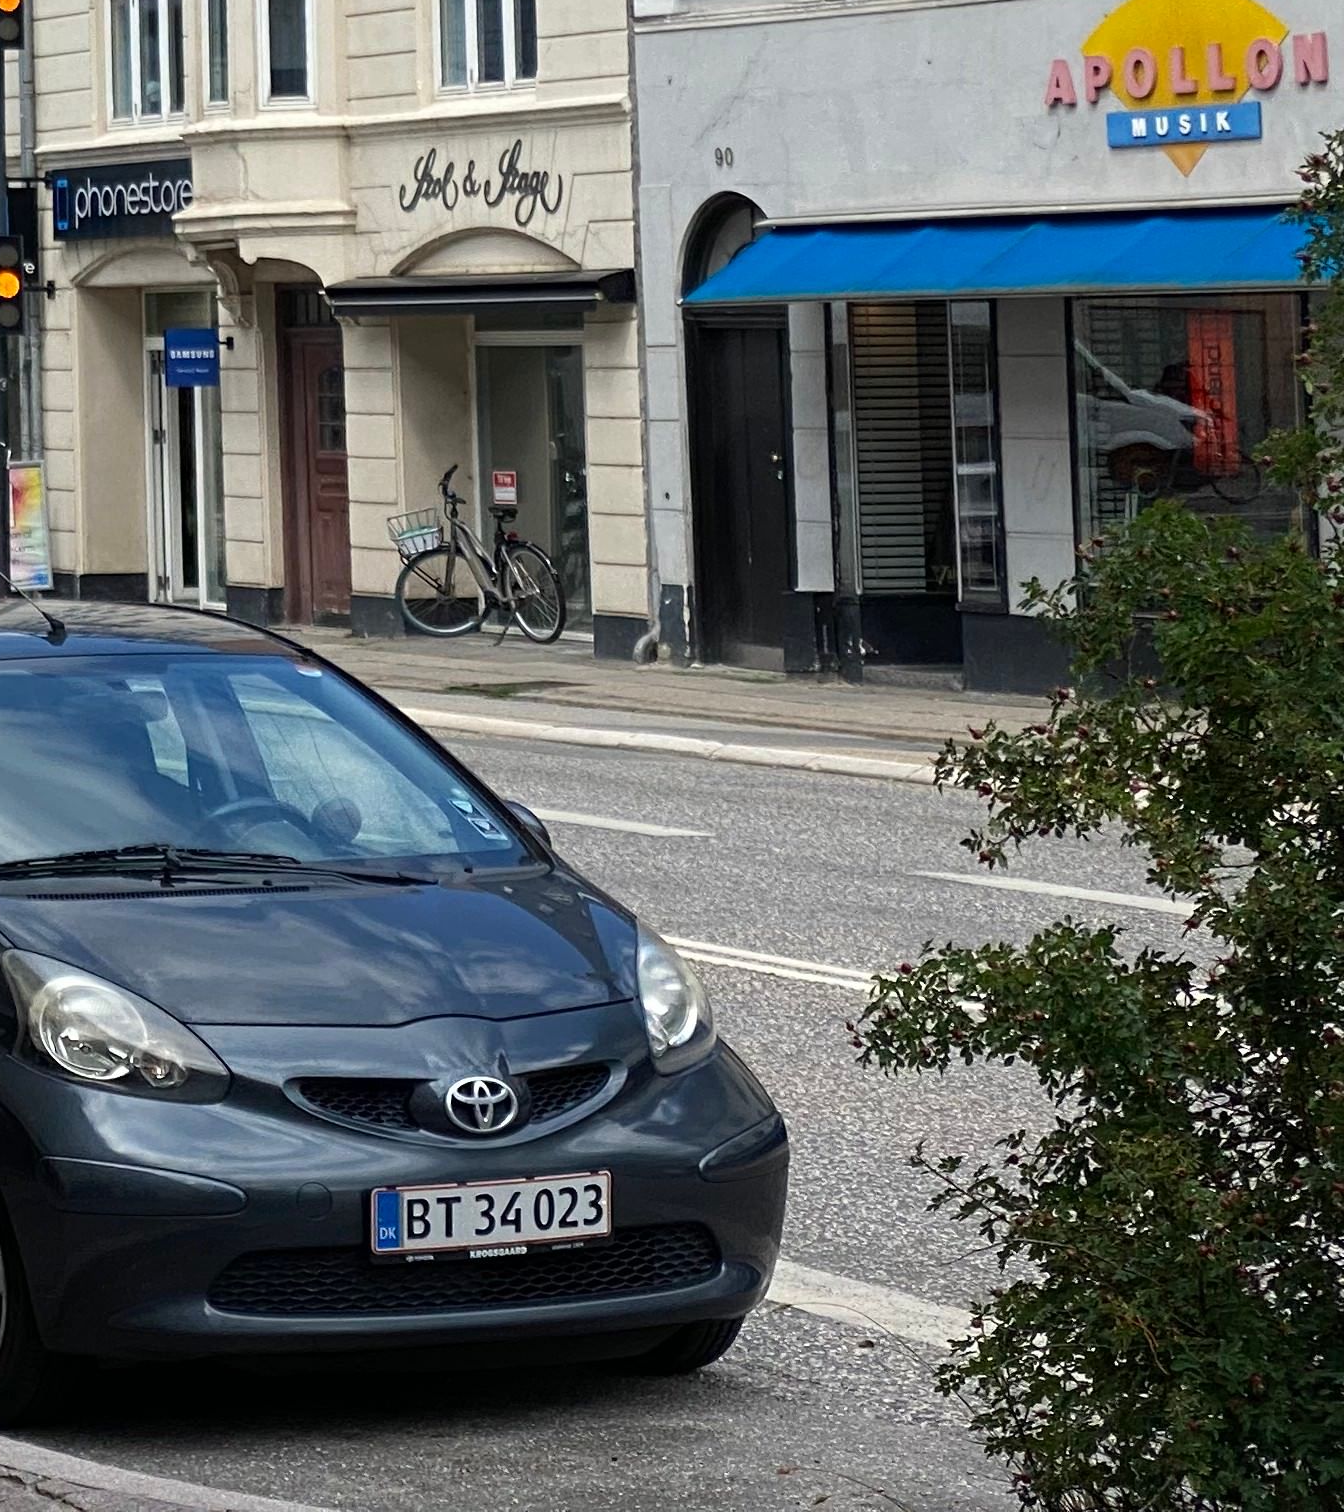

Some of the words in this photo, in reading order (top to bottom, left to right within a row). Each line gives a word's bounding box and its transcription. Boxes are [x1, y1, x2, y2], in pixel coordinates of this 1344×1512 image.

[1044, 32, 1329, 107] APOLLON
[1132, 110, 1232, 138] MUSIK
[714, 147, 734, 167] 90
[463, 160, 482, 197] &
[75, 172, 193, 230] phonestore
[407, 1197, 461, 1240] BT
[475, 1191, 522, 1236] 34
[533, 1184, 604, 1232] 023
[379, 1225, 397, 1239] DK
